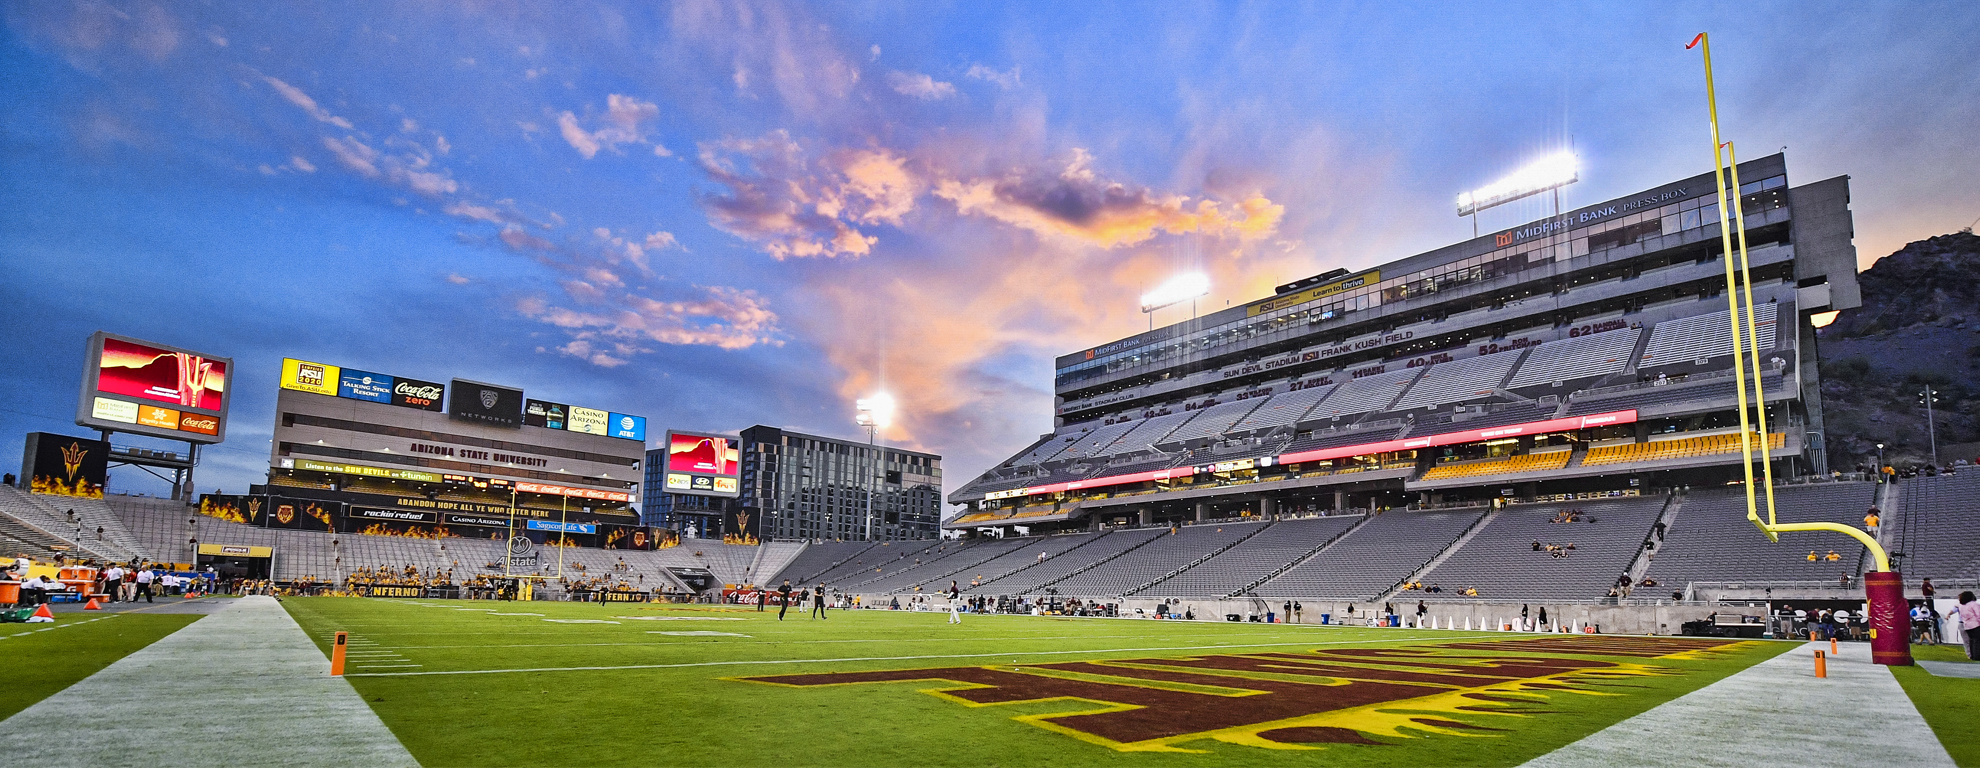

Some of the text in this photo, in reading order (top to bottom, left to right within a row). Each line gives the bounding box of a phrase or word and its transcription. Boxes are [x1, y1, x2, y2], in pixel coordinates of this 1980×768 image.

[1516, 187, 1688, 241] MIDFIRST BANK PRESS BOX
[1312, 287, 1332, 298] Learn
[1342, 279, 1364, 290] thrive
[1260, 302, 1275, 313] ASU
[1569, 325, 1592, 338] 62
[1124, 338, 1140, 348] BANK
[1512, 337, 1529, 345] RON
[1224, 330, 1414, 378] SUN DEVIL STADIUM ASU FRANK KUSH FIELD
[1478, 343, 1498, 356] 52
[1407, 357, 1425, 368] 40
[1352, 369, 1363, 378] 11
[298, 377, 322, 386] 2020
[1290, 381, 1303, 392] 27
[342, 381, 390, 394] TALKING STICK
[354, 388, 380, 397] RESORT
[405, 396, 432, 407] zero
[1094, 397, 1118, 407] STADIUM
[1119, 394, 1135, 402] CLUB
[1237, 392, 1249, 401] 33
[1185, 402, 1197, 411] 84
[461, 412, 513, 424] NETWORKS
[574, 407, 604, 418] CASINO
[1143, 411, 1155, 419] 42
[569, 414, 607, 427] ARIZONA
[1104, 418, 1114, 426] 50
[618, 430, 635, 439] AT&T
[410, 443, 548, 467] ARIZONA STATE UNIVERSITY
[305, 463, 325, 471] Listen
[345, 466, 362, 474] SUN
[363, 468, 390, 477] DEVILS
[398, 498, 435, 508] ABANDON
[438, 502, 458, 510] HOPE
[460, 503, 474, 511] ALL
[476, 504, 485, 512] YE
[487, 505, 504, 514] WHO
[531, 509, 550, 518] HERE
[452, 516, 505, 526] CASINO ARIZONA
[372, 586, 419, 597] NFERNO
